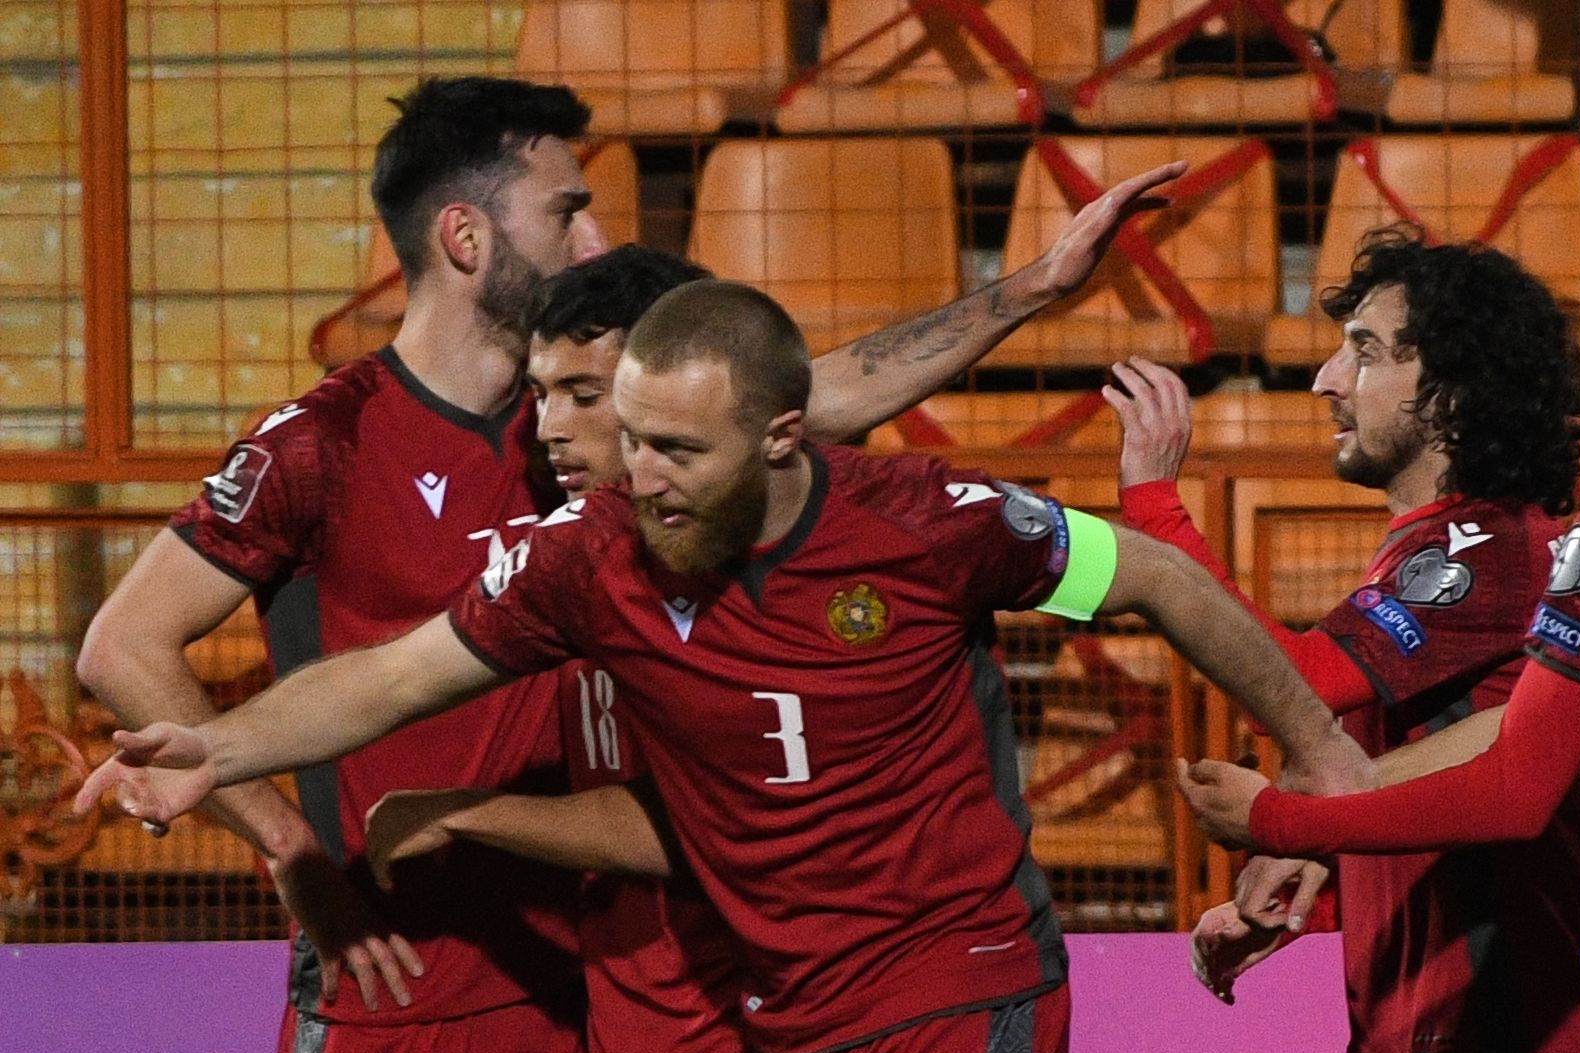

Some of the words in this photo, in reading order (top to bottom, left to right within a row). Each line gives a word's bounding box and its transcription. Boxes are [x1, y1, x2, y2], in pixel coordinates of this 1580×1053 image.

[1373, 602, 1422, 650] RESPECT
[577, 669, 621, 770] 18
[752, 691, 810, 784] 3
